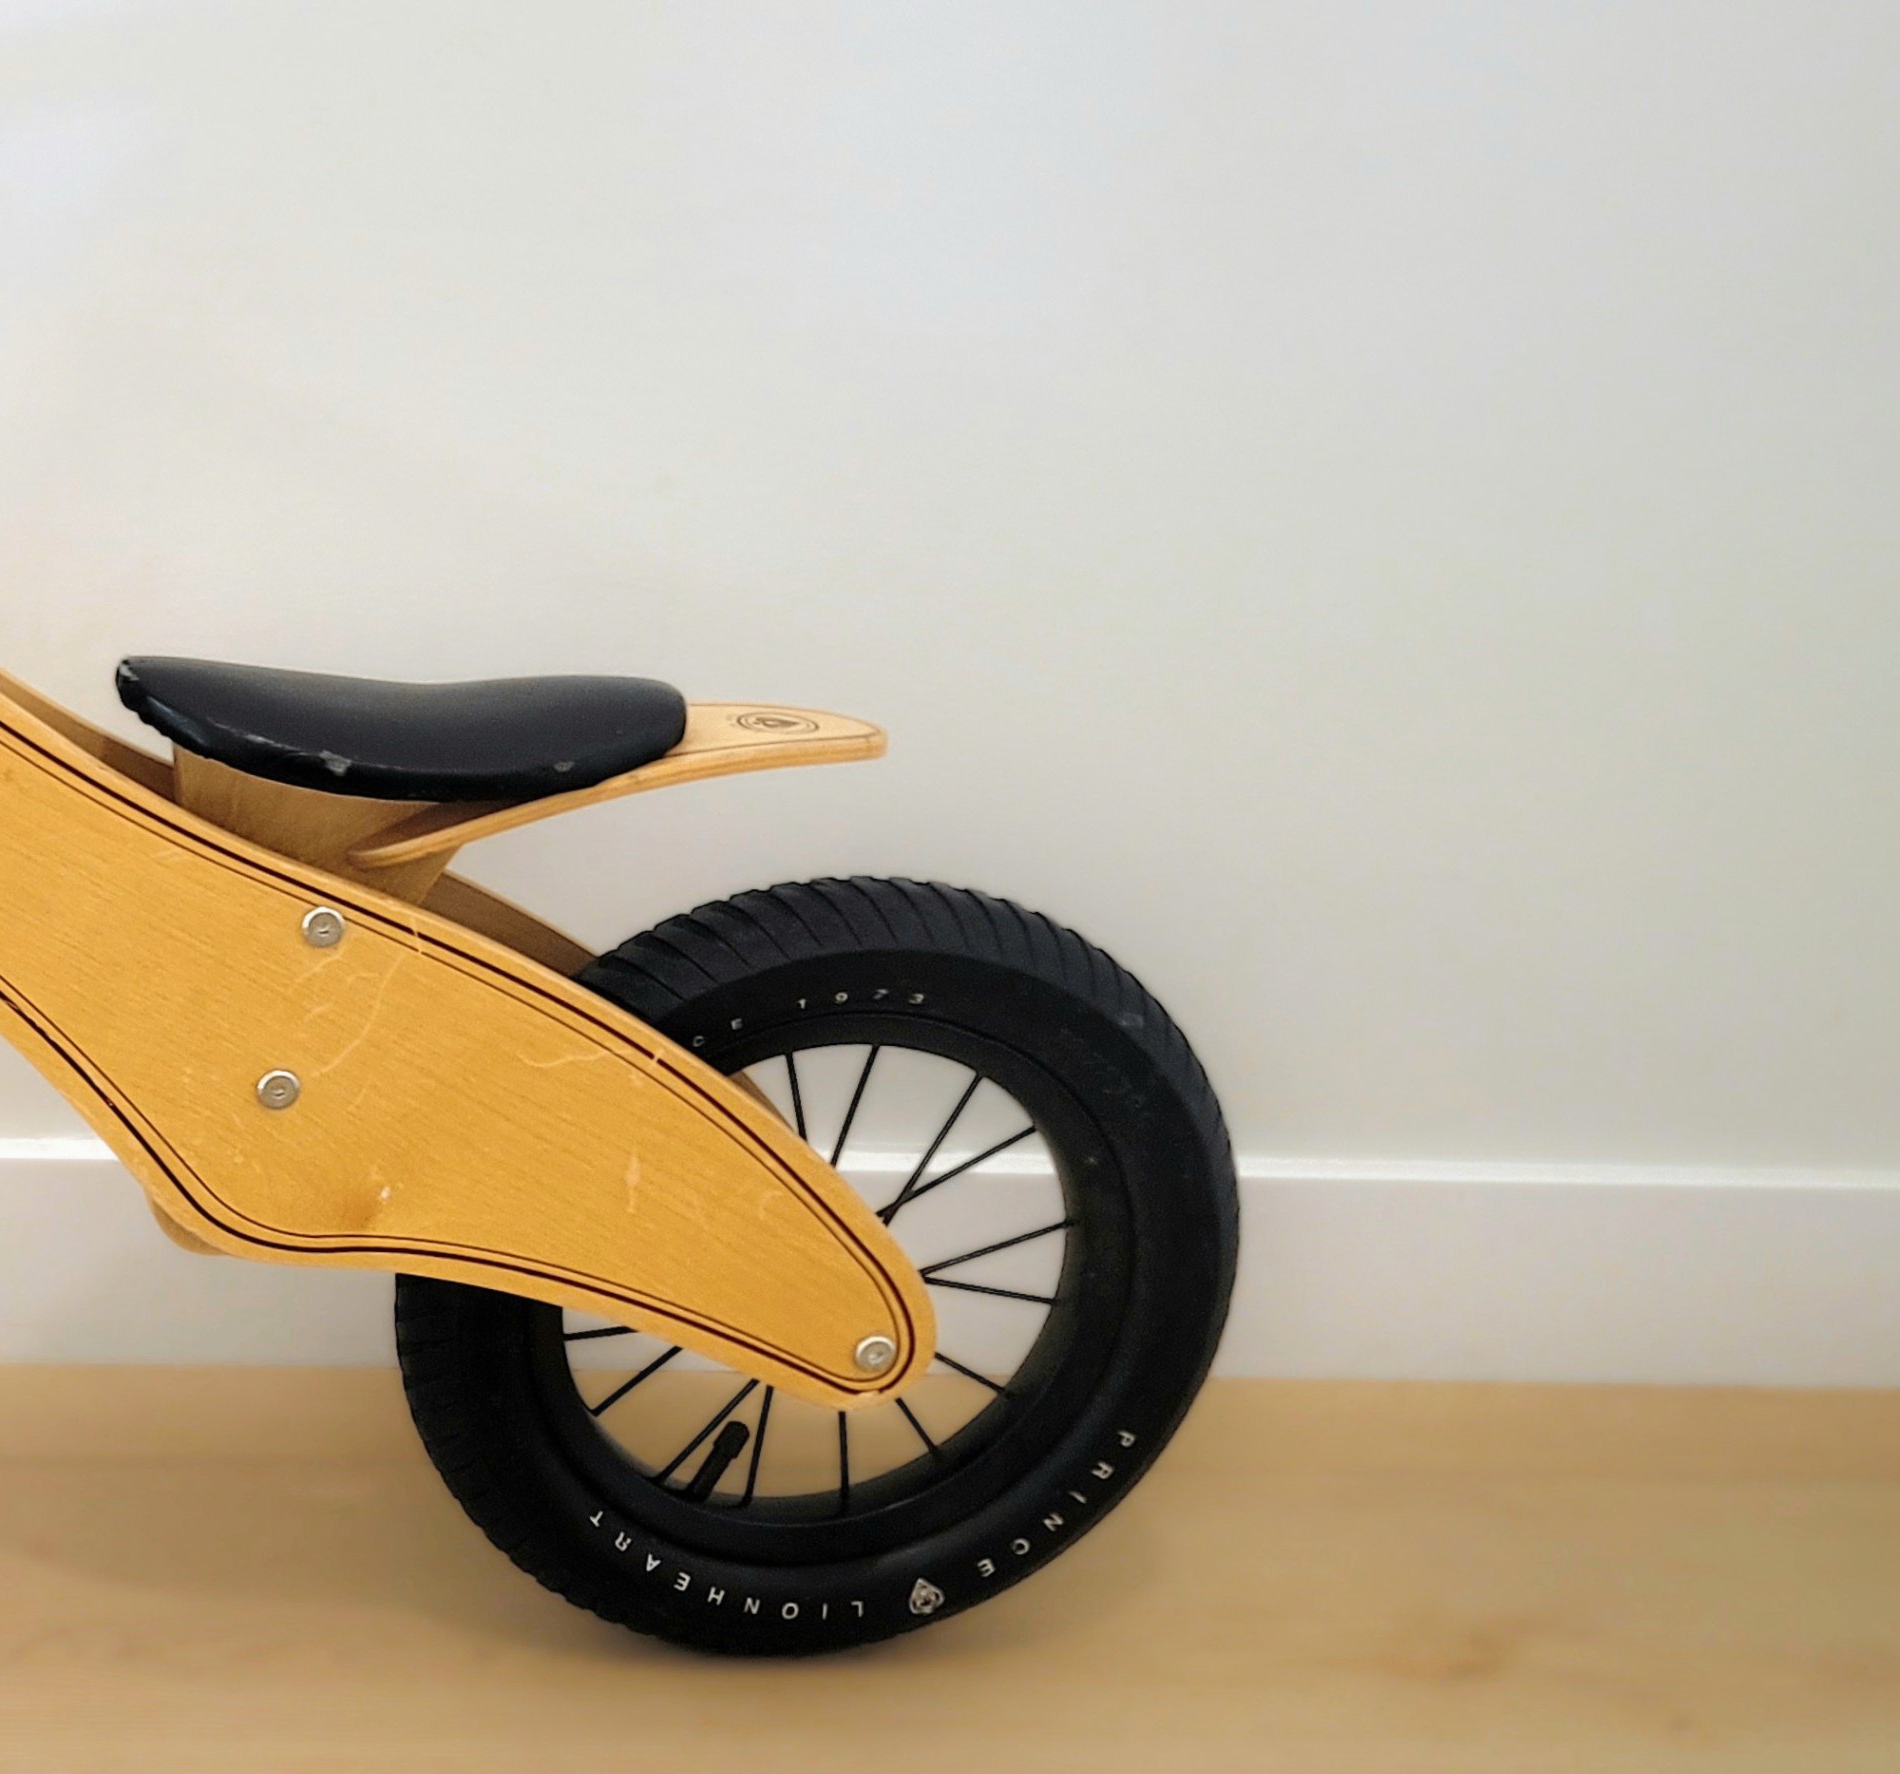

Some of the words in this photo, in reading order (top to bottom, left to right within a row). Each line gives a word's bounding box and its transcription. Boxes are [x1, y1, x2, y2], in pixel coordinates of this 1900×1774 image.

[797, 987, 925, 1009] 1973
[976, 1429, 1136, 1579] PRINCE
[588, 1510, 864, 1621] LIONHEART
